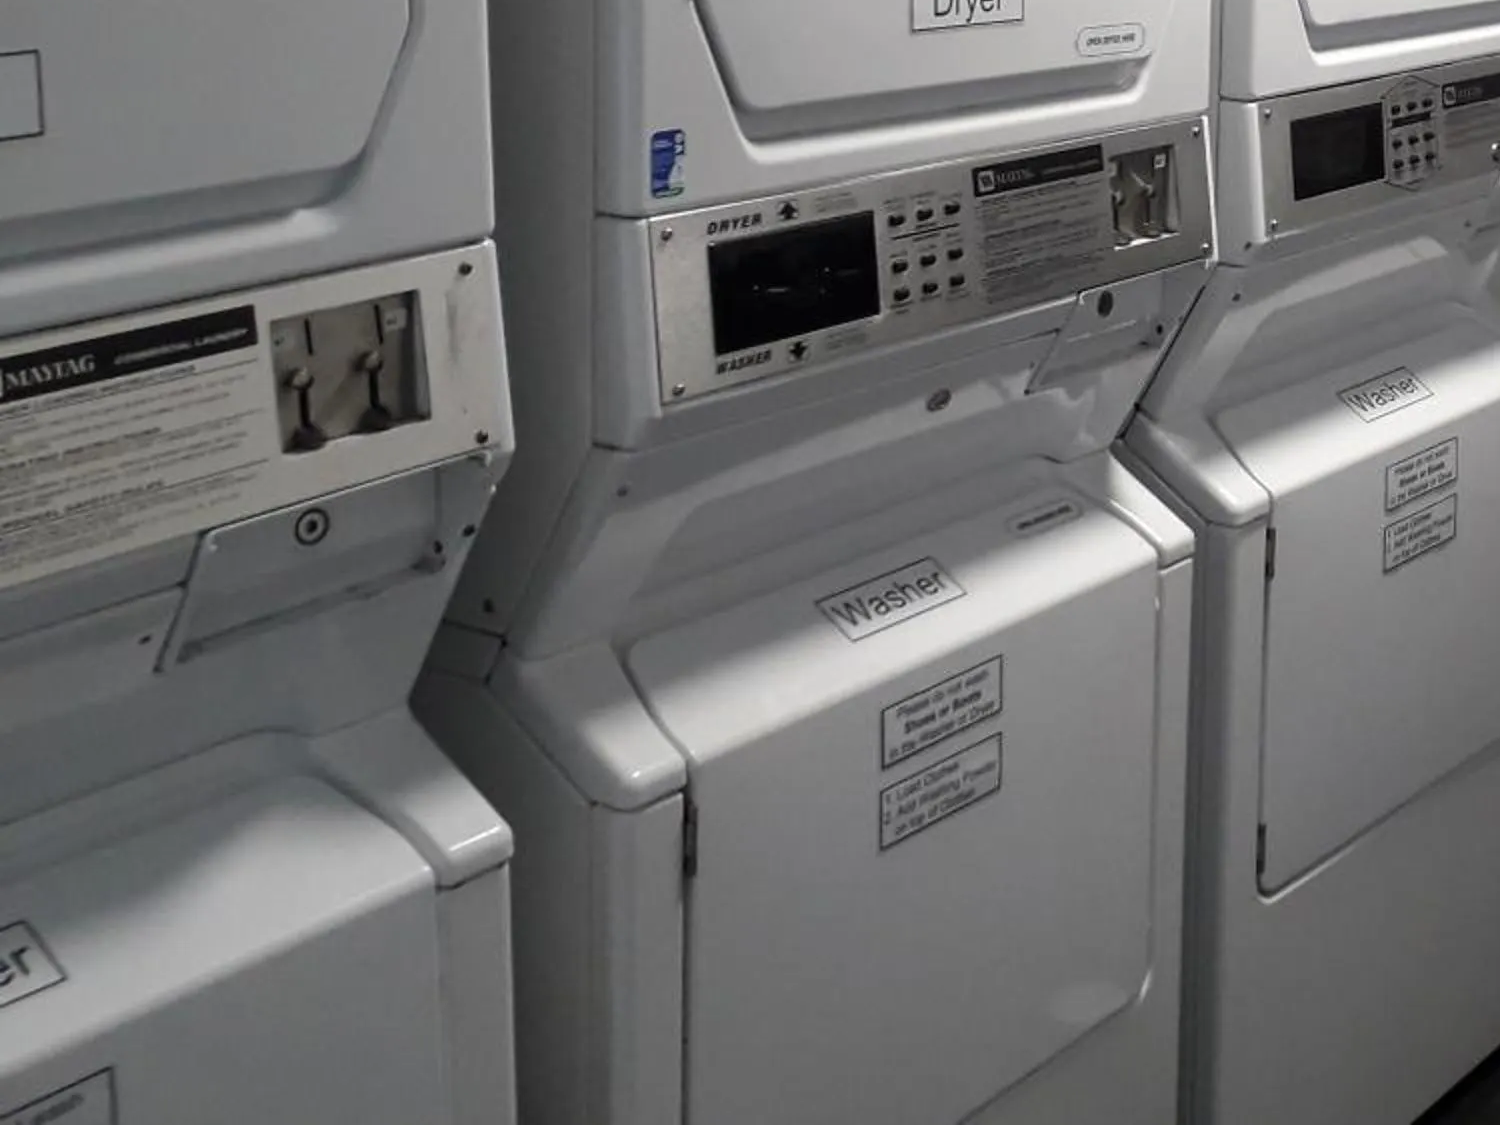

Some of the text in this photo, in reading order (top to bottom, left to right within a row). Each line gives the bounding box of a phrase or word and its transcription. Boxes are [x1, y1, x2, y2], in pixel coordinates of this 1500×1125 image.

[707, 213, 762, 235] DRYER
[6, 353, 97, 390] MAYTAG
[716, 349, 772, 375] WASHER
[1347, 377, 1418, 412] Washer
[830, 572, 946, 626] Washer
